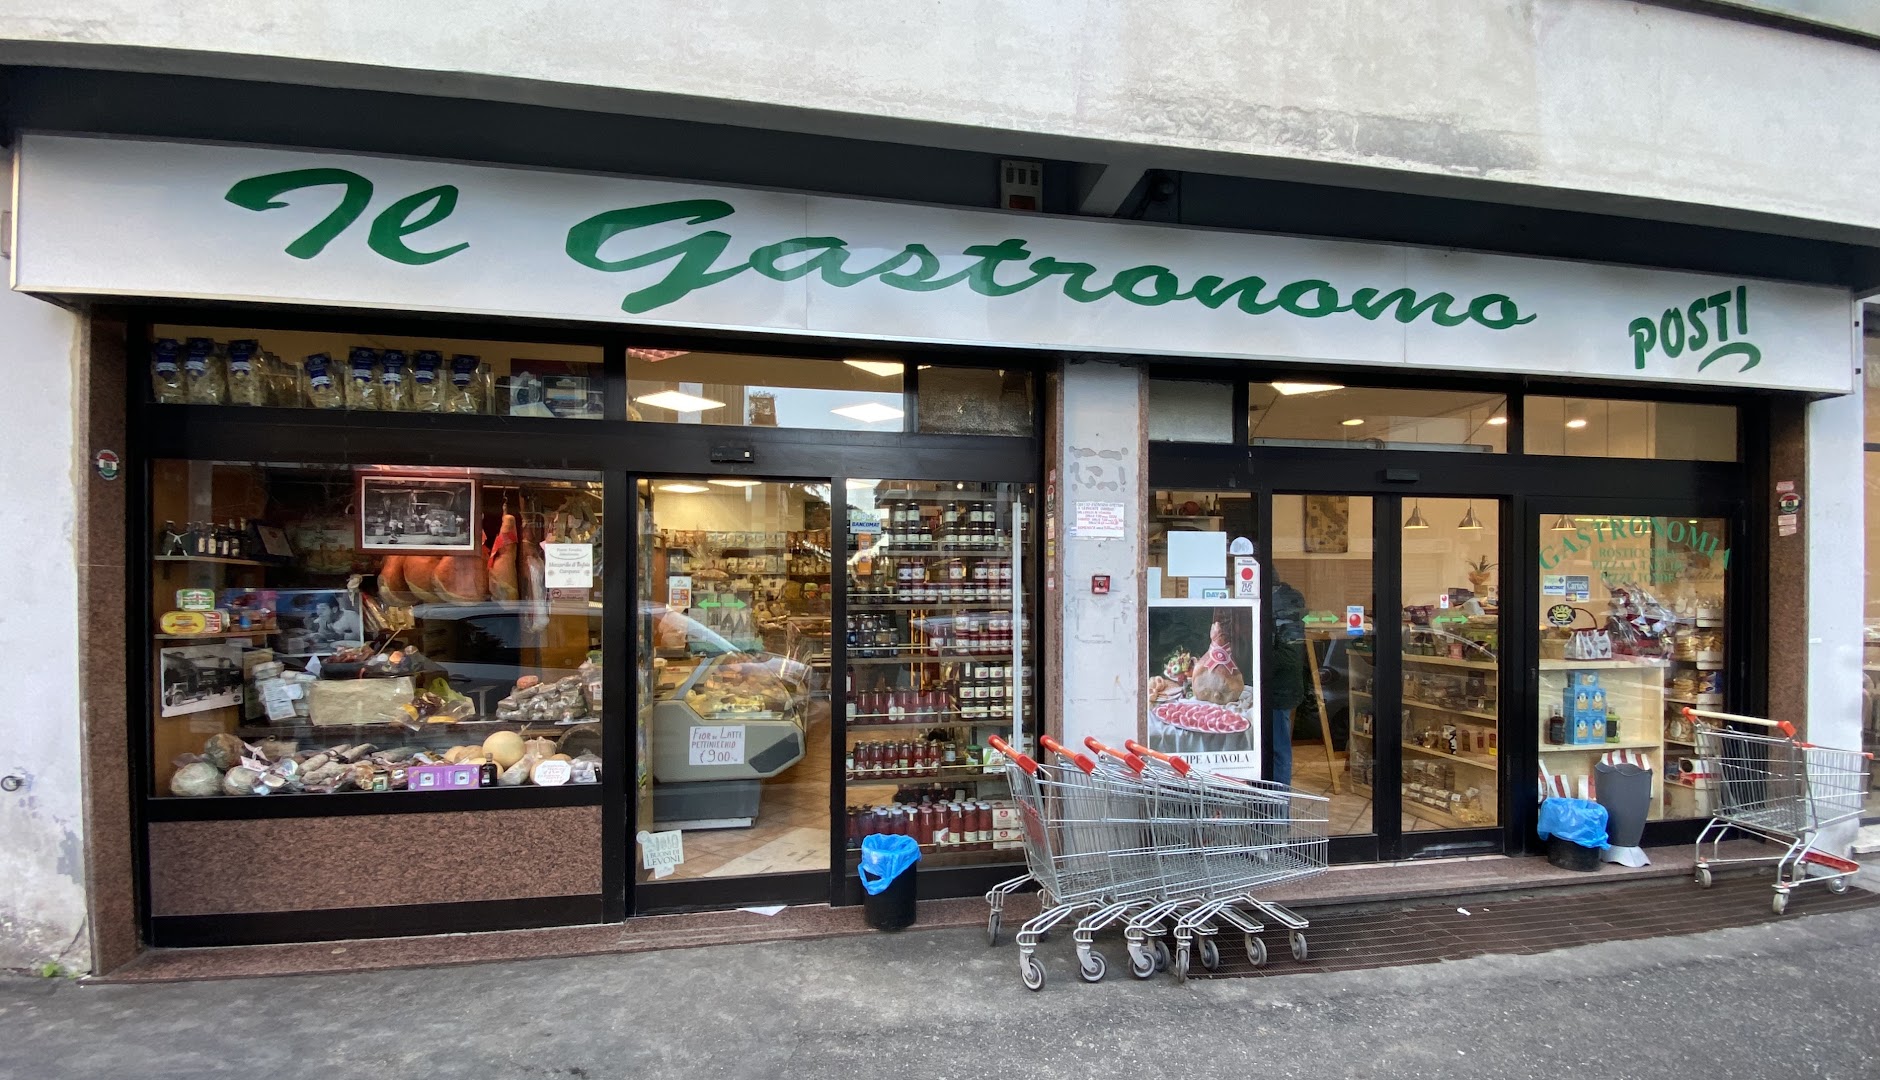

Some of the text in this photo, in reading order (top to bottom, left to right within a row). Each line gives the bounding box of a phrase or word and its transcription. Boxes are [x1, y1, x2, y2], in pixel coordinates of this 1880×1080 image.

[566, 200, 1537, 329] Gastronomo
[1628, 285, 1748, 370] POSTI
[1206, 754, 1212, 764] A
[1214, 753, 1250, 764] TAVOLA
[647, 855, 680, 866] LEVONI
